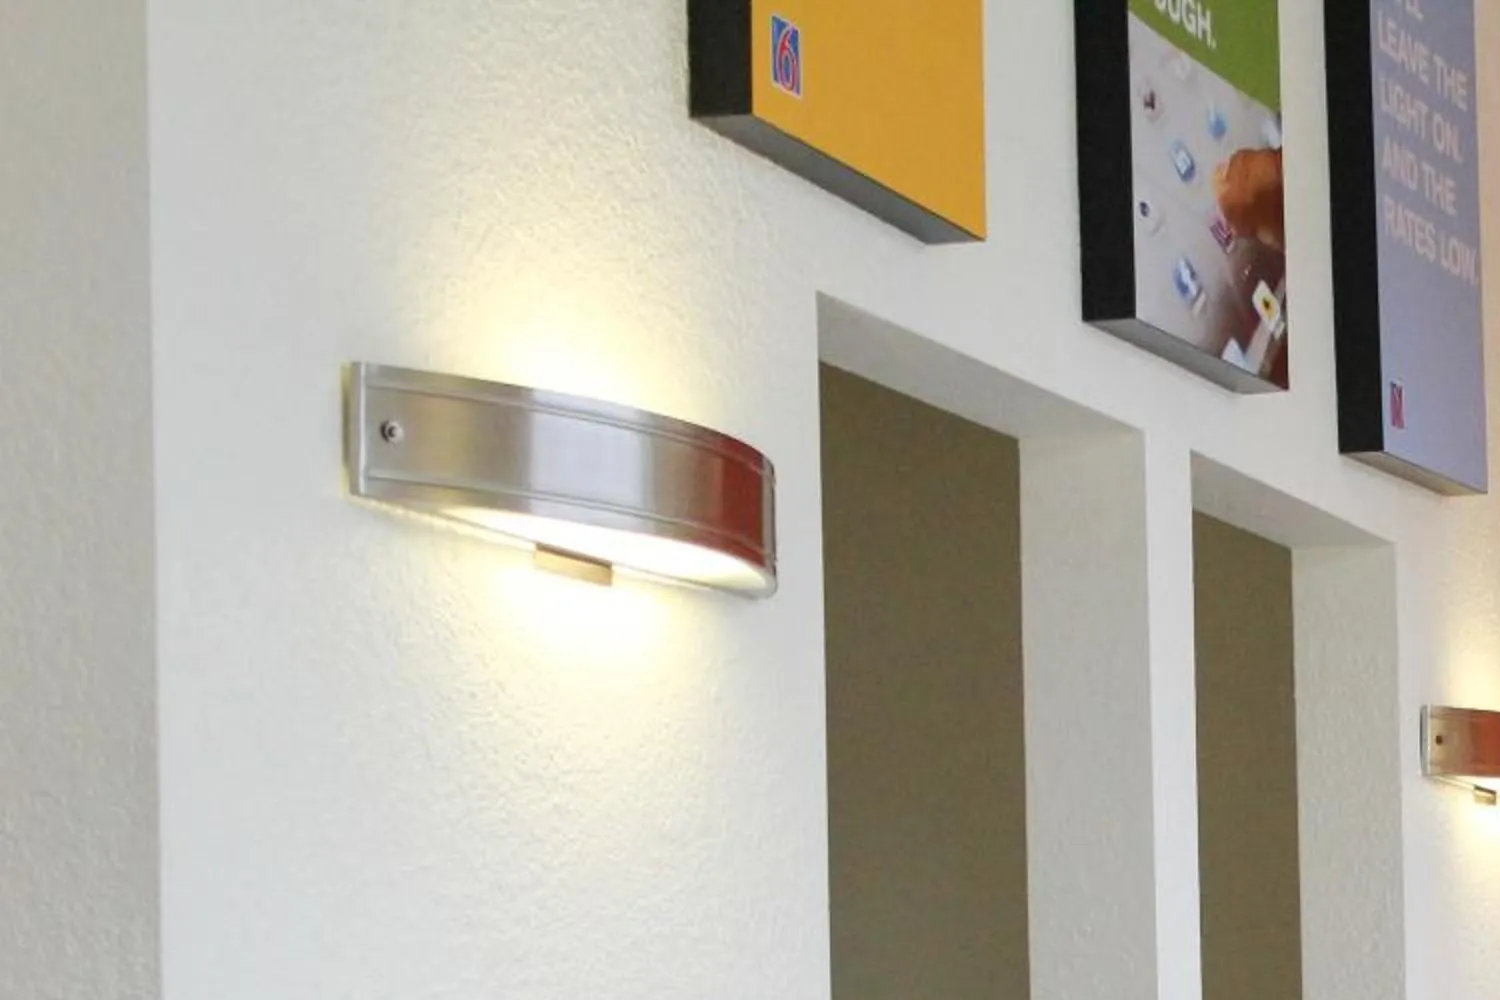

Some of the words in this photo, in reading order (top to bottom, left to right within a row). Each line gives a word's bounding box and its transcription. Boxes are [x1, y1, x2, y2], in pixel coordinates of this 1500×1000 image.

[1379, 9, 1429, 86] LEAVE
[1433, 54, 1467, 112] THE
[1381, 78, 1428, 141] LIGHT
[1383, 136, 1418, 191] AND
[1422, 160, 1457, 216] THE
[1383, 193, 1436, 263] RATES
